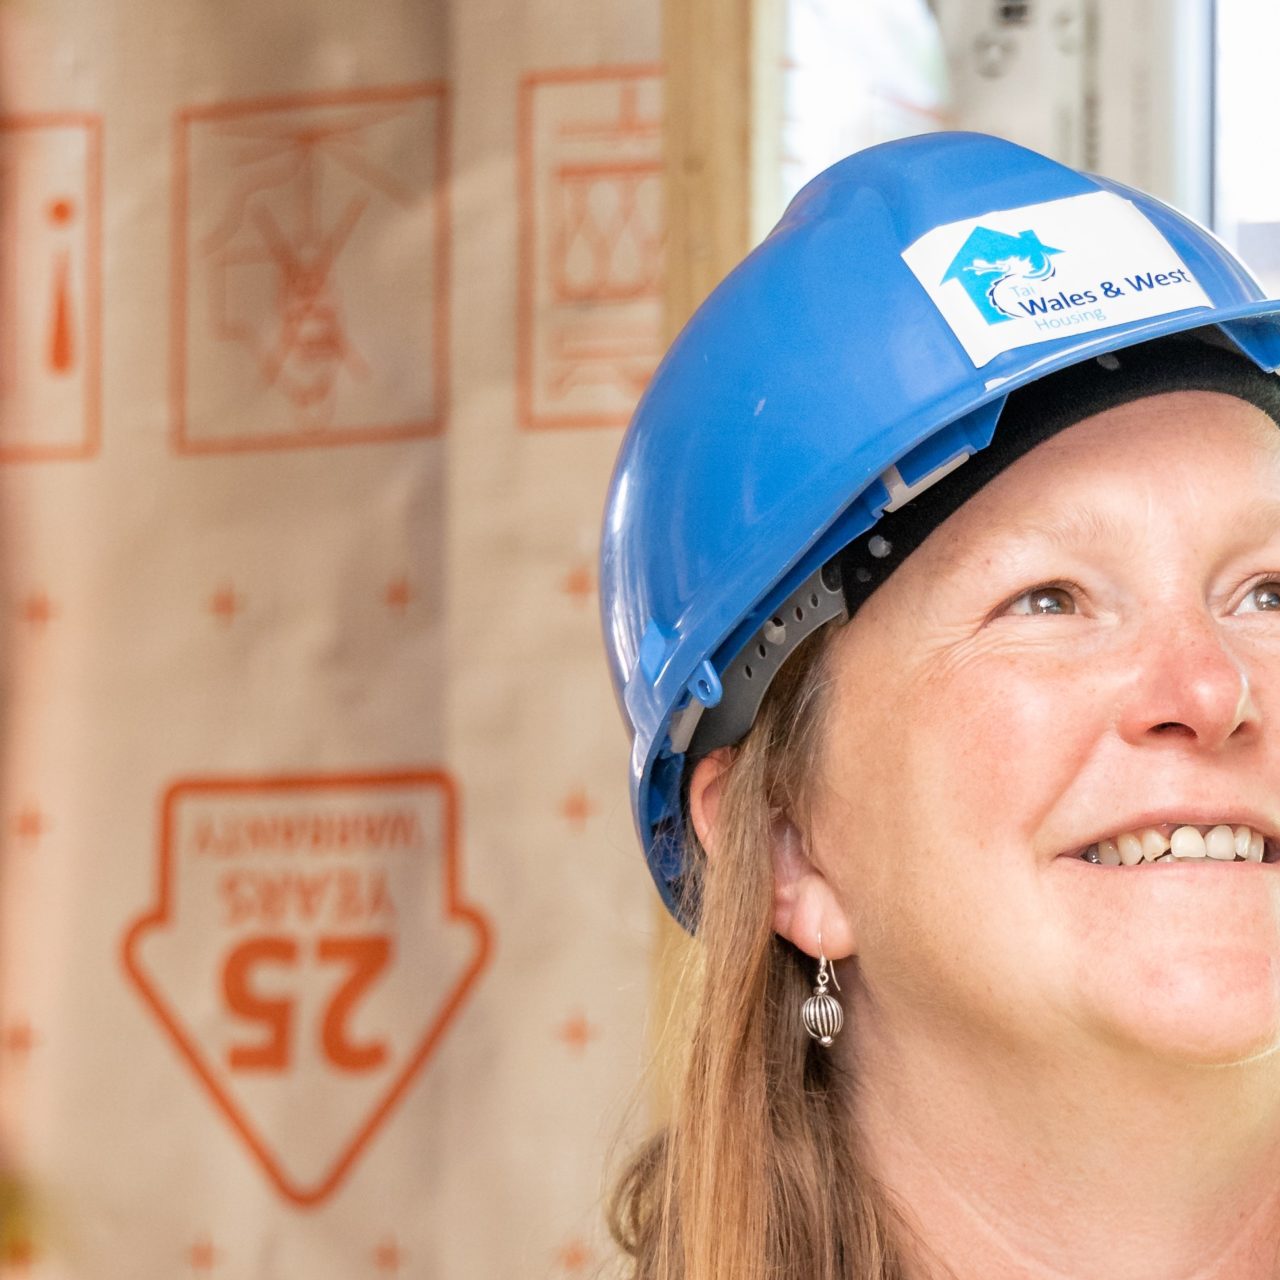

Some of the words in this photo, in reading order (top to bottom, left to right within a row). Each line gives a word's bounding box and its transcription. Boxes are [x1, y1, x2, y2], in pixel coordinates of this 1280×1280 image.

[1011, 285, 1036, 298] Tai
[1018, 291, 1098, 317] Wales
[1100, 281, 1125, 298] &
[1125, 267, 1191, 292] West
[1035, 307, 1107, 331] Housing
[219, 870, 394, 923] YEARS
[221, 936, 394, 1075] 25
